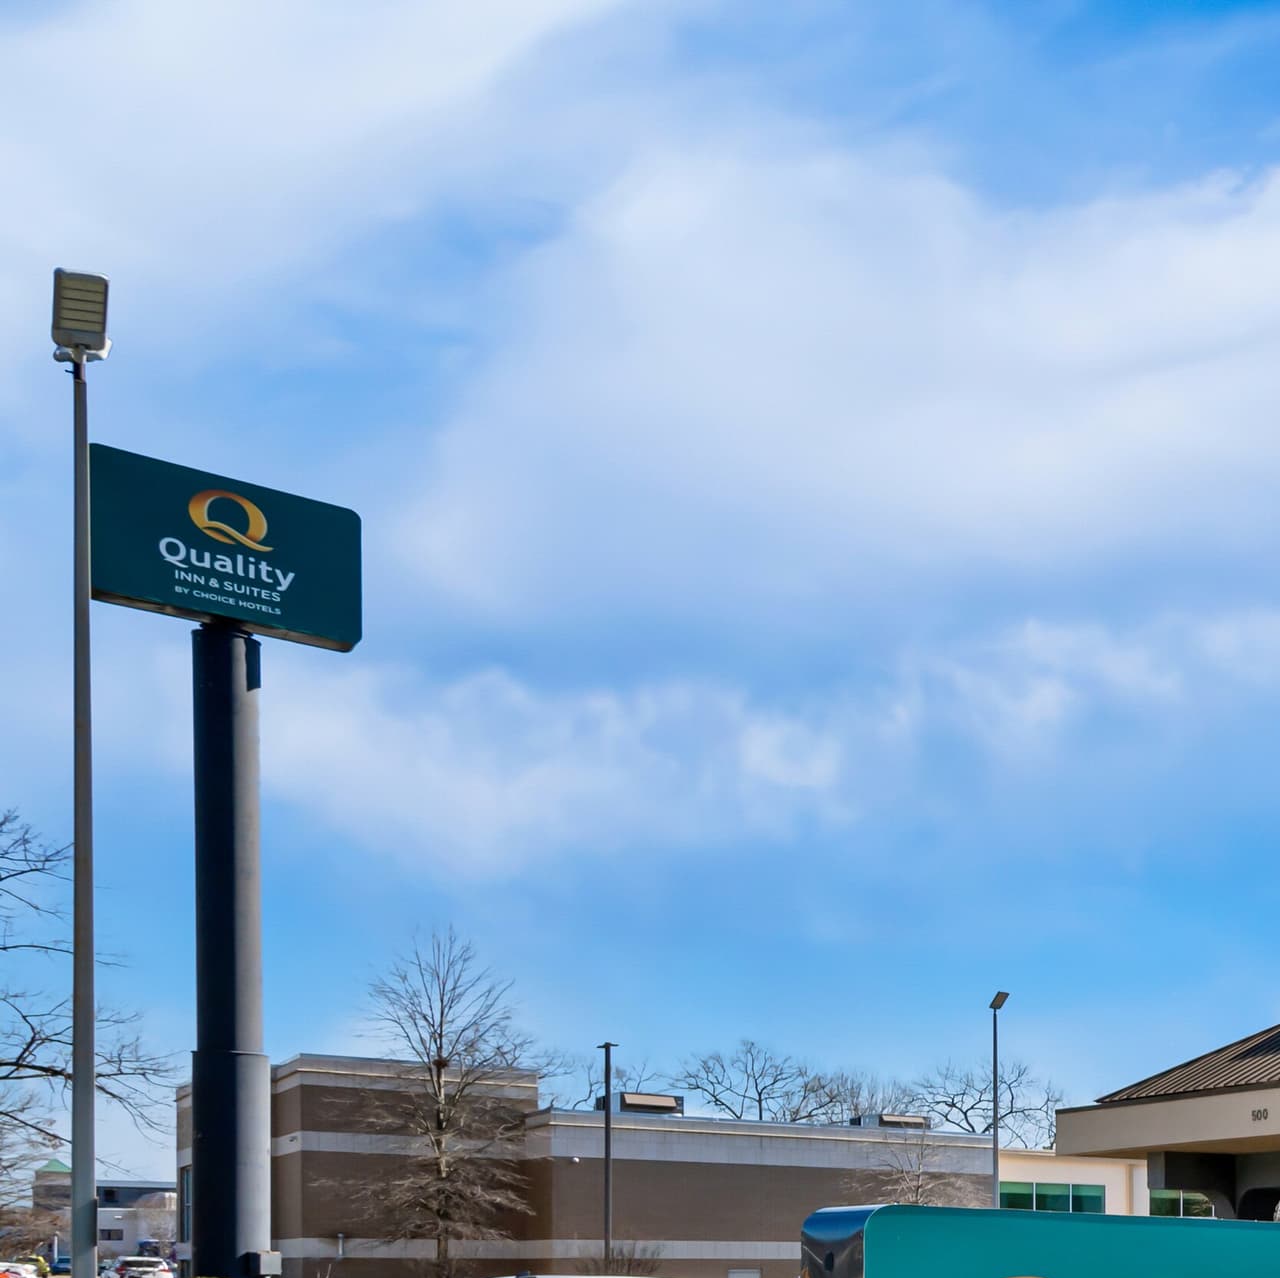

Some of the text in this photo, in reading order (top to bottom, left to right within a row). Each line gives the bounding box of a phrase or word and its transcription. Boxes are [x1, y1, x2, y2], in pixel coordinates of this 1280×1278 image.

[159, 537, 296, 591] Quality
[174, 569, 281, 602] INN & SUITES
[174, 585, 282, 615] BY CHOICE HOTELS
[1251, 1108, 1269, 1121] 500
